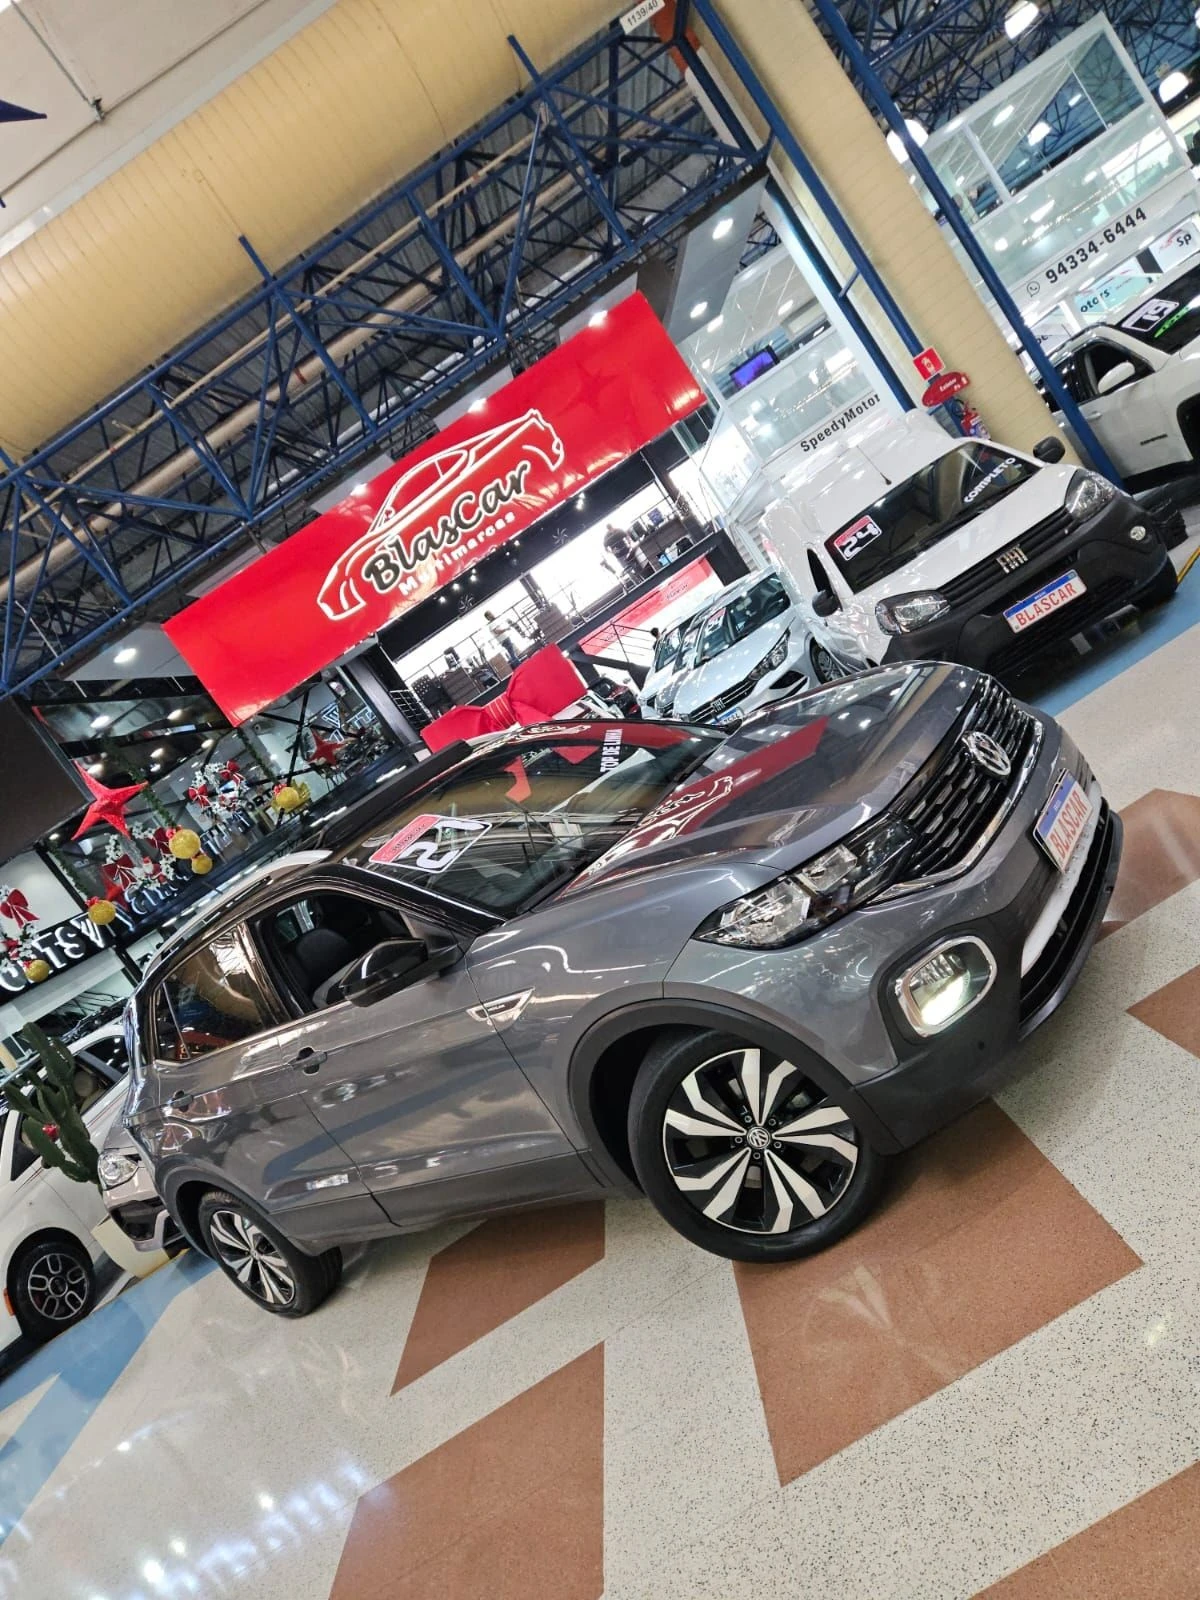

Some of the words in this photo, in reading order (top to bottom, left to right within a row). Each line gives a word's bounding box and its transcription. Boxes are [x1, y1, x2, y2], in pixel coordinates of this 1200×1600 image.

[1045, 207, 1147, 284] 94334-6444
[964, 457, 1016, 503] COMPLETO
[363, 461, 530, 593] BlasCar
[844, 521, 880, 559] 24
[1016, 582, 1077, 627] BLASCAR
[1051, 790, 1087, 861] BLASCAR
